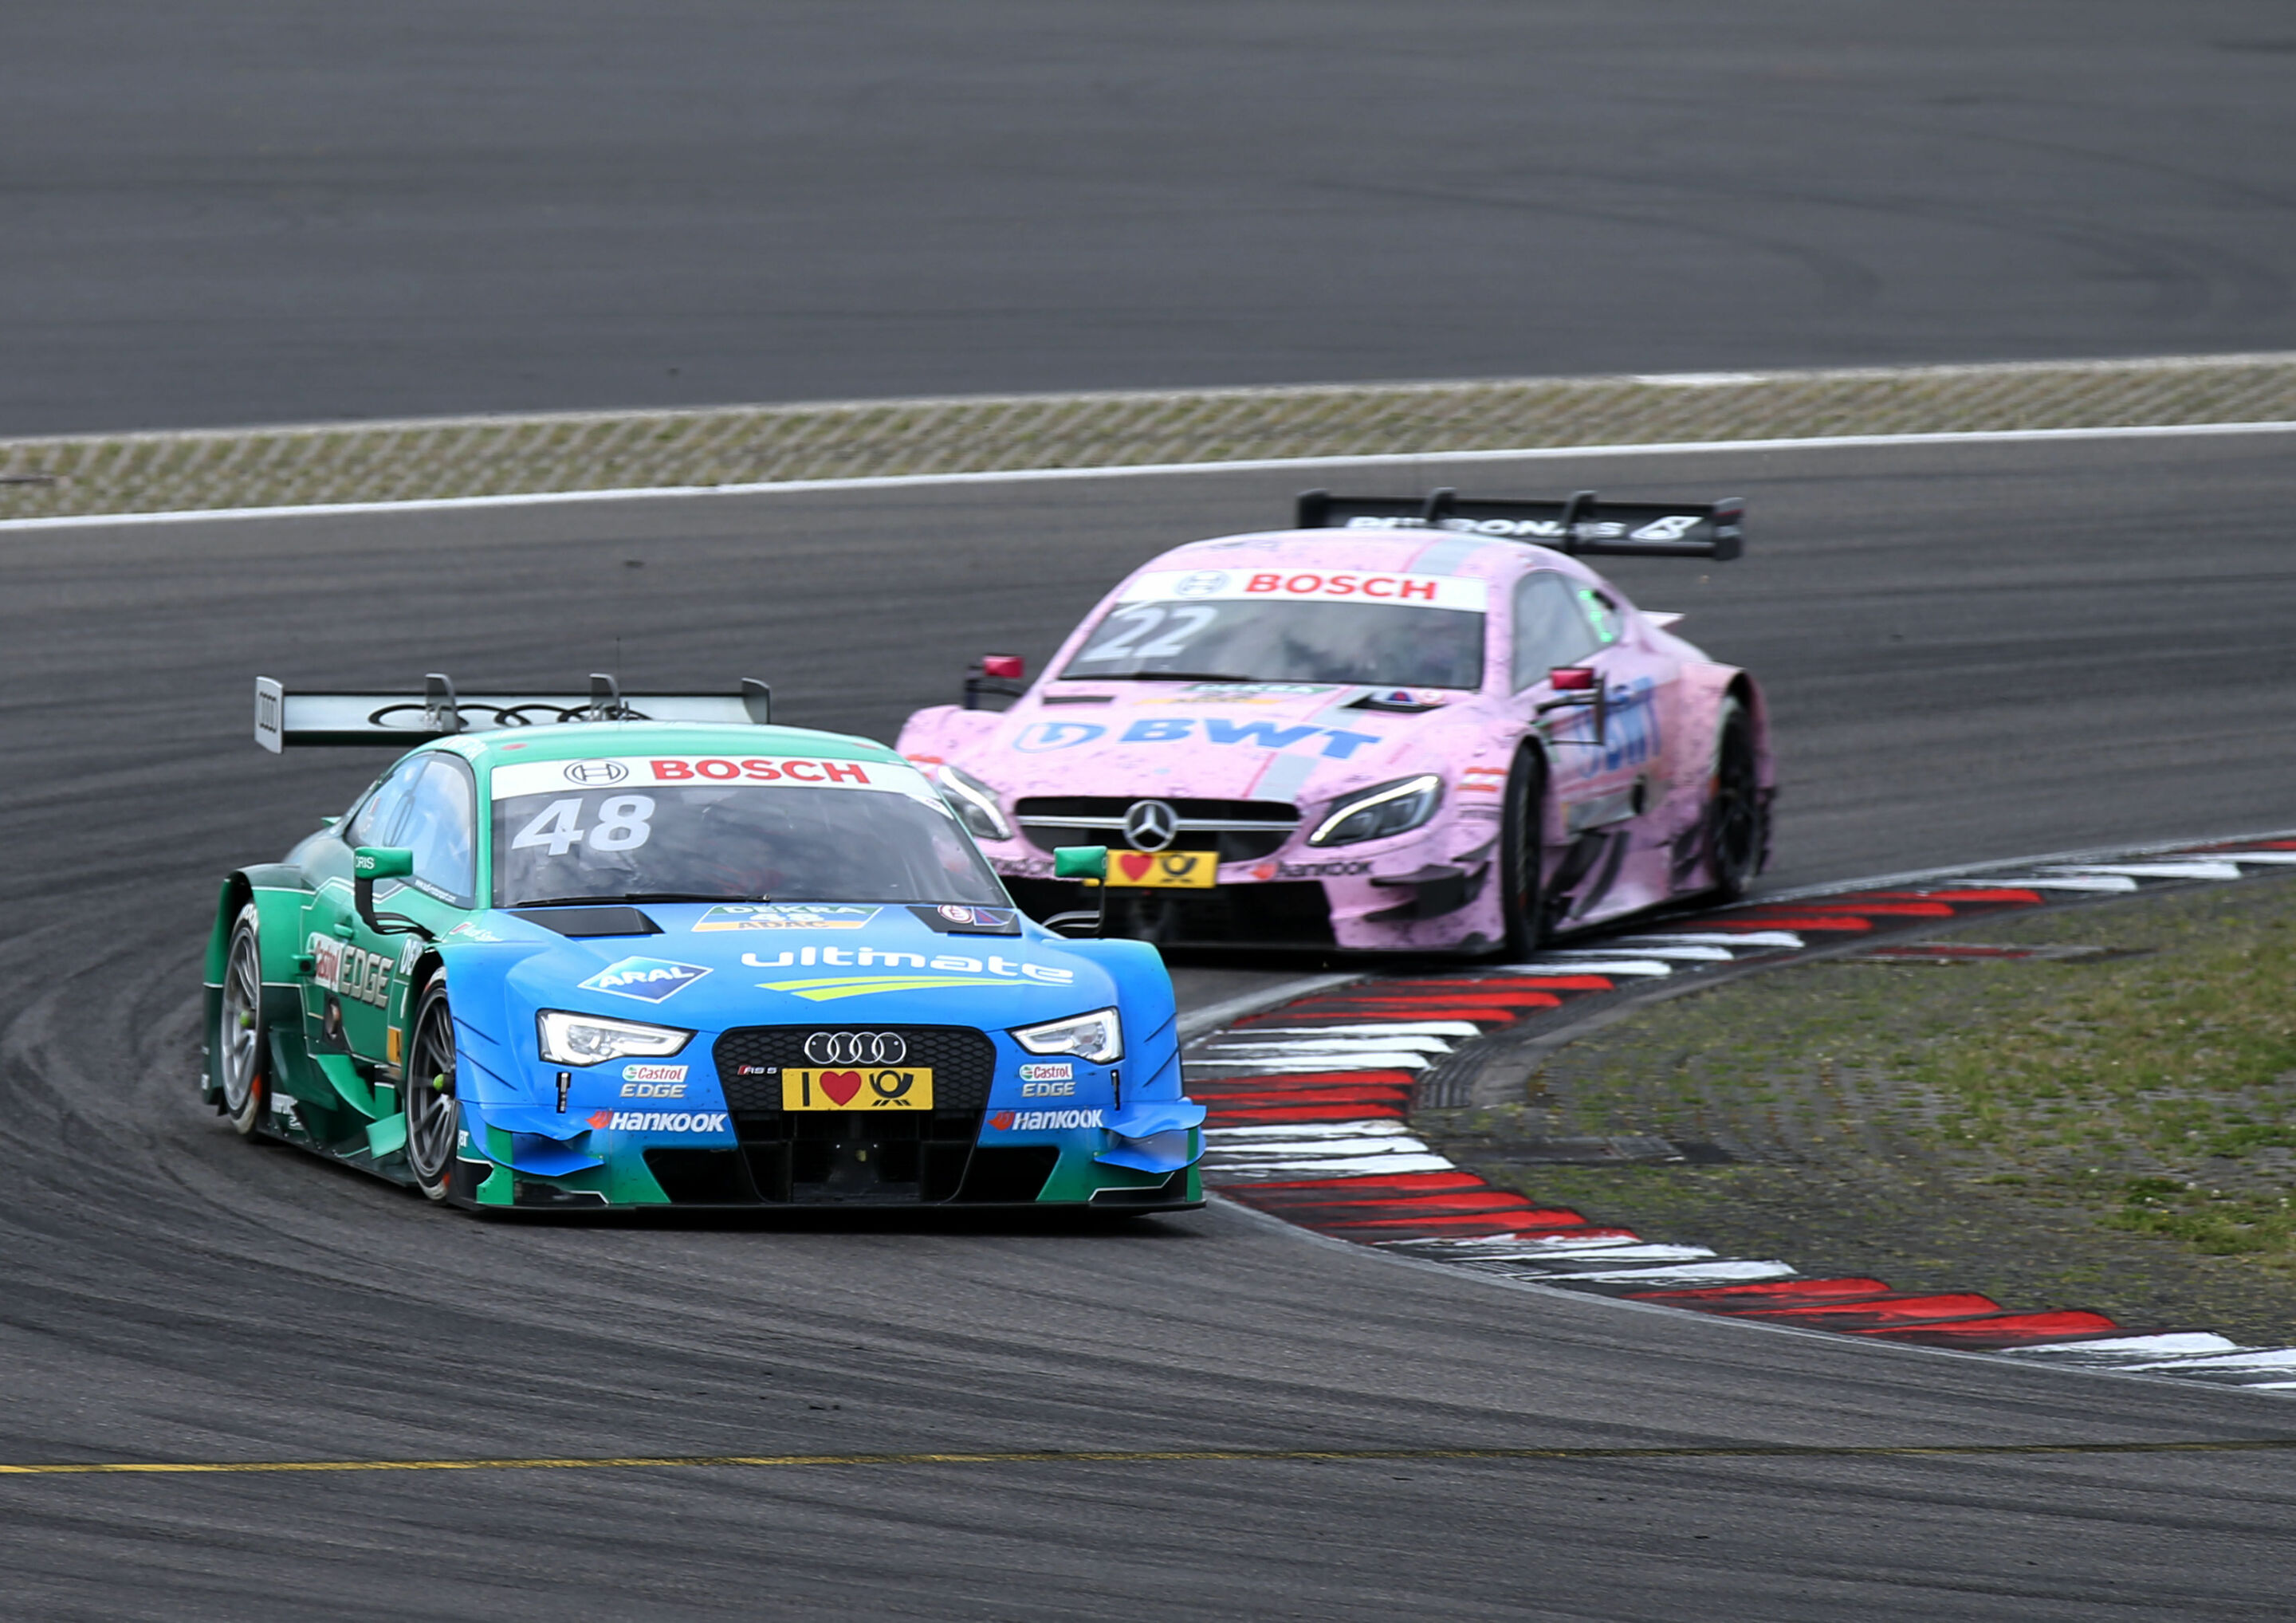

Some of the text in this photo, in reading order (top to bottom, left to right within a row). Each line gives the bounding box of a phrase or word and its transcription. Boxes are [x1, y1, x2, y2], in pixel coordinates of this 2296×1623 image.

[1246, 574, 1437, 599] BOSCH
[1082, 604, 1216, 661] 22
[1119, 718, 1382, 760] BWT
[651, 760, 871, 784] BOSCH
[511, 795, 656, 856] 48
[722, 906, 867, 914] DEKRA
[339, 944, 395, 1009] EDGE
[741, 945, 1075, 983] ultimate
[599, 964, 695, 990] ARAL
[638, 1067, 682, 1081] Castrol
[1033, 1066, 1069, 1079] Castrol
[619, 1083, 688, 1098] EDGE
[801, 1071, 810, 1106] I
[1021, 1082, 1076, 1098] EDGE
